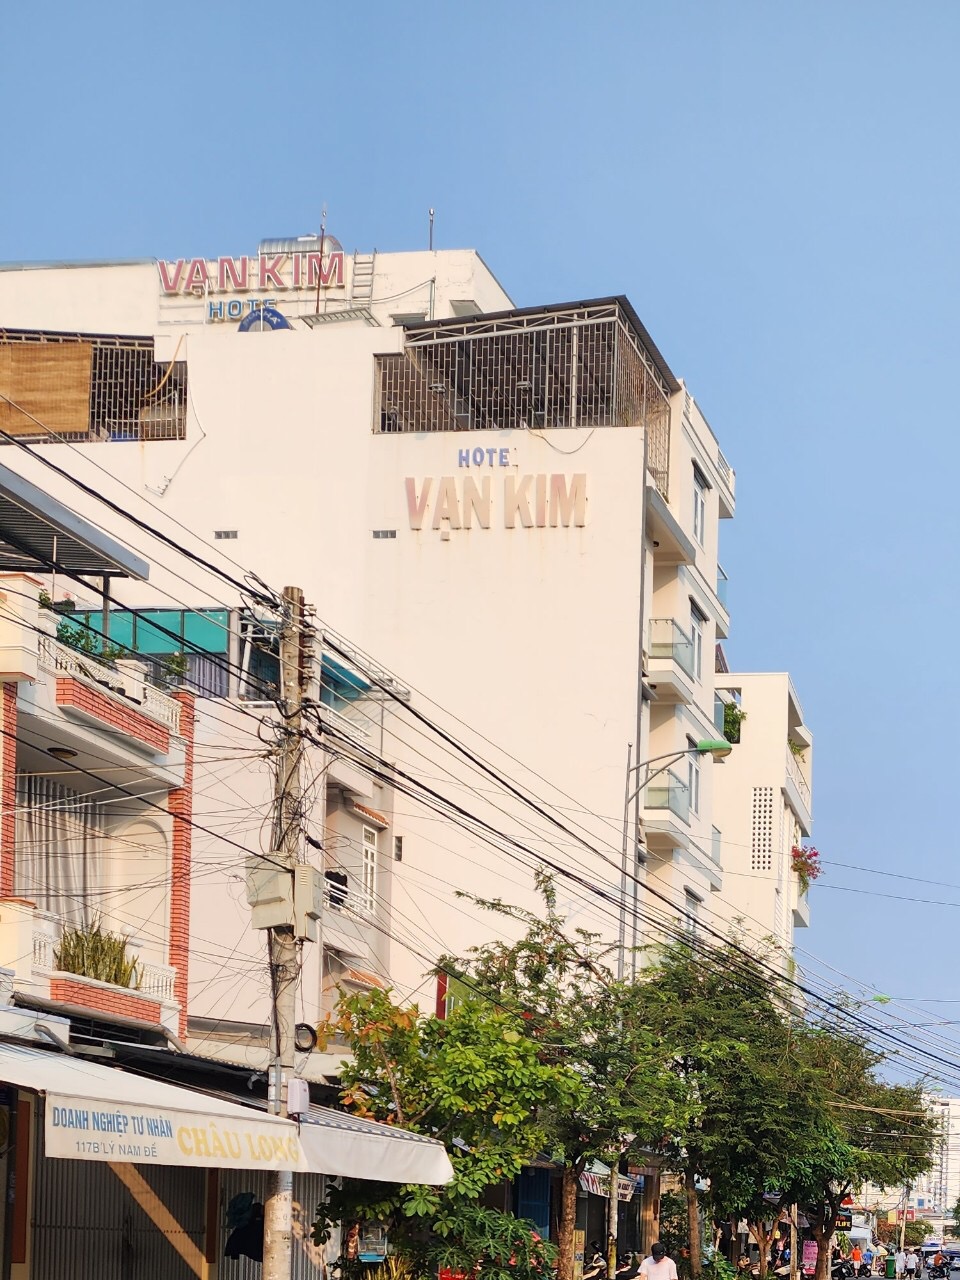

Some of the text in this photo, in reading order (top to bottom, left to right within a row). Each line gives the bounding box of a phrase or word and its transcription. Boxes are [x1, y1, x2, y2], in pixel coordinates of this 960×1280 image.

[258, 251, 345, 289] KIM
[504, 473, 587, 529] KIM
[52, 1106, 89, 1130] DOANH
[92, 1110, 129, 1138] NGHIỆP
[131, 1115, 144, 1135] TƯ
[119, 1145, 141, 1156] NAM
[177, 1121, 299, 1162] CHÂU LONG
